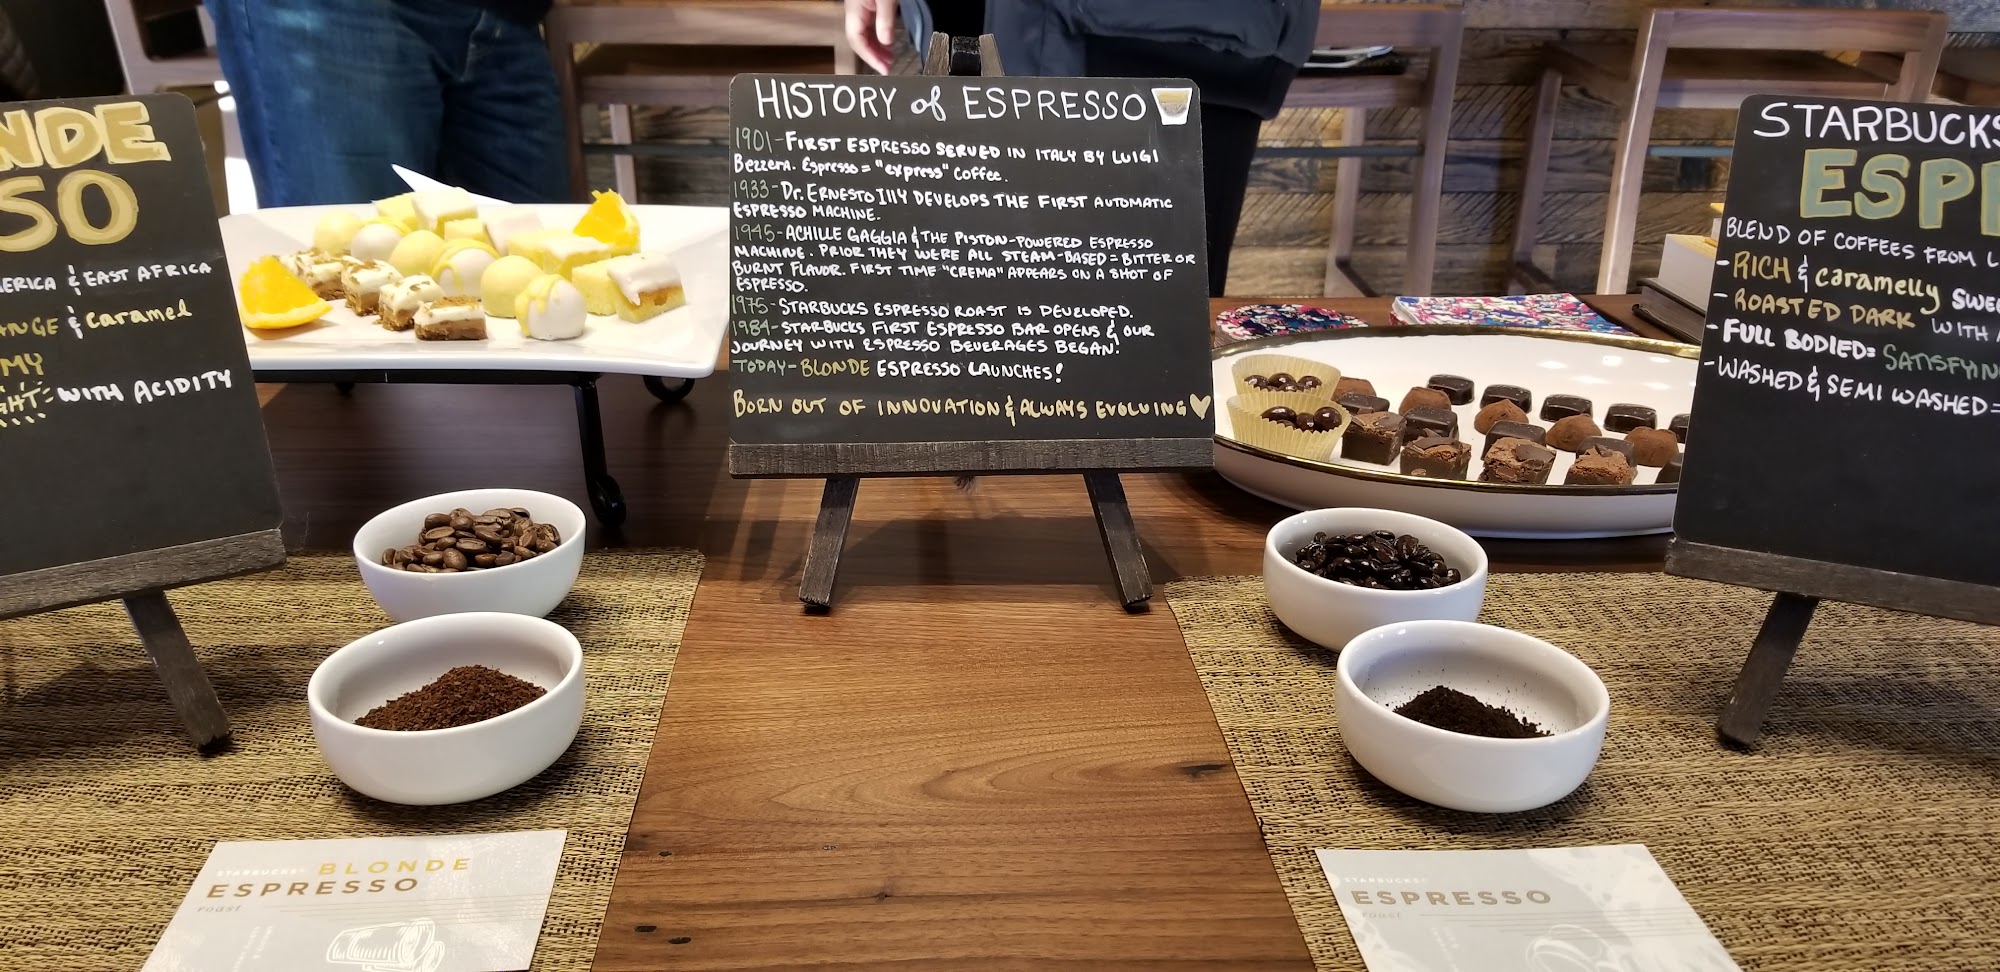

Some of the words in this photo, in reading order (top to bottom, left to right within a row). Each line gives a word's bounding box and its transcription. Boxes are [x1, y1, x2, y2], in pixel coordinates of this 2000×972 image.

[754, 78, 897, 121] HISTORY
[910, 85, 947, 122] of
[962, 86, 1147, 121] ESPRESSO
[847, 137, 931, 155] ESPRESSO
[935, 141, 1000, 160] SERVED
[1007, 146, 1026, 159] IN
[1035, 148, 1077, 163] ITALY
[1083, 150, 1105, 165] BY
[1112, 148, 1159, 164] LUIGI
[806, 183, 876, 204] ERNESTO
[912, 189, 990, 208] DEVELOPS
[993, 193, 1029, 209] THE
[1037, 195, 1088, 210] FIRST
[1094, 196, 1173, 209] AUTOMATIC
[733, 201, 807, 218] ESPRESSO
[812, 205, 881, 222] MACHINE.
[846, 227, 907, 245] GAGGIA
[1089, 237, 1154, 249] ESPRESSO
[1726, 217, 1791, 244] BLEND
[1798, 229, 1826, 246] OF
[1833, 232, 1916, 260] COFFEES
[1923, 246, 1976, 267] FROM
[818, 244, 865, 258] PRIOR
[867, 247, 906, 260] THEY
[914, 250, 960, 260] WERE
[967, 249, 993, 262] ALL
[1121, 253, 1173, 265] BITTER
[1175, 254, 1196, 265] OR
[83, 269, 129, 287] EAST
[137, 261, 212, 283] AFRICA
[732, 261, 784, 277] BURNT
[790, 261, 846, 278] FLAVOR.
[850, 263, 892, 276] FIRST
[898, 265, 937, 276] TIME
[1007, 268, 1068, 280] APPEARS
[1072, 269, 1091, 280] ON
[1096, 268, 1105, 280] A
[1108, 268, 1149, 280] SHOT
[1152, 269, 1174, 281] OF
[736, 278, 809, 293] ESPRESSO.
[874, 303, 950, 317] ESPRESSO
[954, 306, 1007, 318] ROAST
[1017, 306, 1033, 316] IS
[1038, 305, 1134, 319] DEVELOPED.
[871, 321, 920, 336] FIRST
[926, 322, 1006, 337] ESPRESSO
[1011, 323, 1050, 336] BAR
[1053, 324, 1101, 338] OPENS
[1123, 324, 1155, 337] OUR
[1849, 306, 1916, 329] DARK
[1931, 317, 1989, 342] WITH
[731, 339, 803, 354] JOURNEY
[811, 340, 854, 351] WITH
[863, 341, 941, 352] ESPRESSO
[949, 340, 1048, 353] BEVERAGES
[876, 359, 962, 378] ESPRESSO
[967, 362, 1064, 384] LAUNCHES!
[57, 383, 124, 402] WITH
[133, 369, 233, 404] ACIDITY
[1827, 374, 1882, 401] SEMI
[733, 388, 784, 418] BORN
[791, 397, 828, 415] OUT
[838, 398, 867, 416] OF
[877, 397, 1000, 417] INNOVATION
[1019, 398, 1088, 419] ALWAYS
[1095, 400, 1187, 419] EVOLVING
[318, 858, 472, 876] BLONDE
[206, 878, 419, 898] ESPRESSO
[1350, 890, 1552, 905] ESPRESSO
